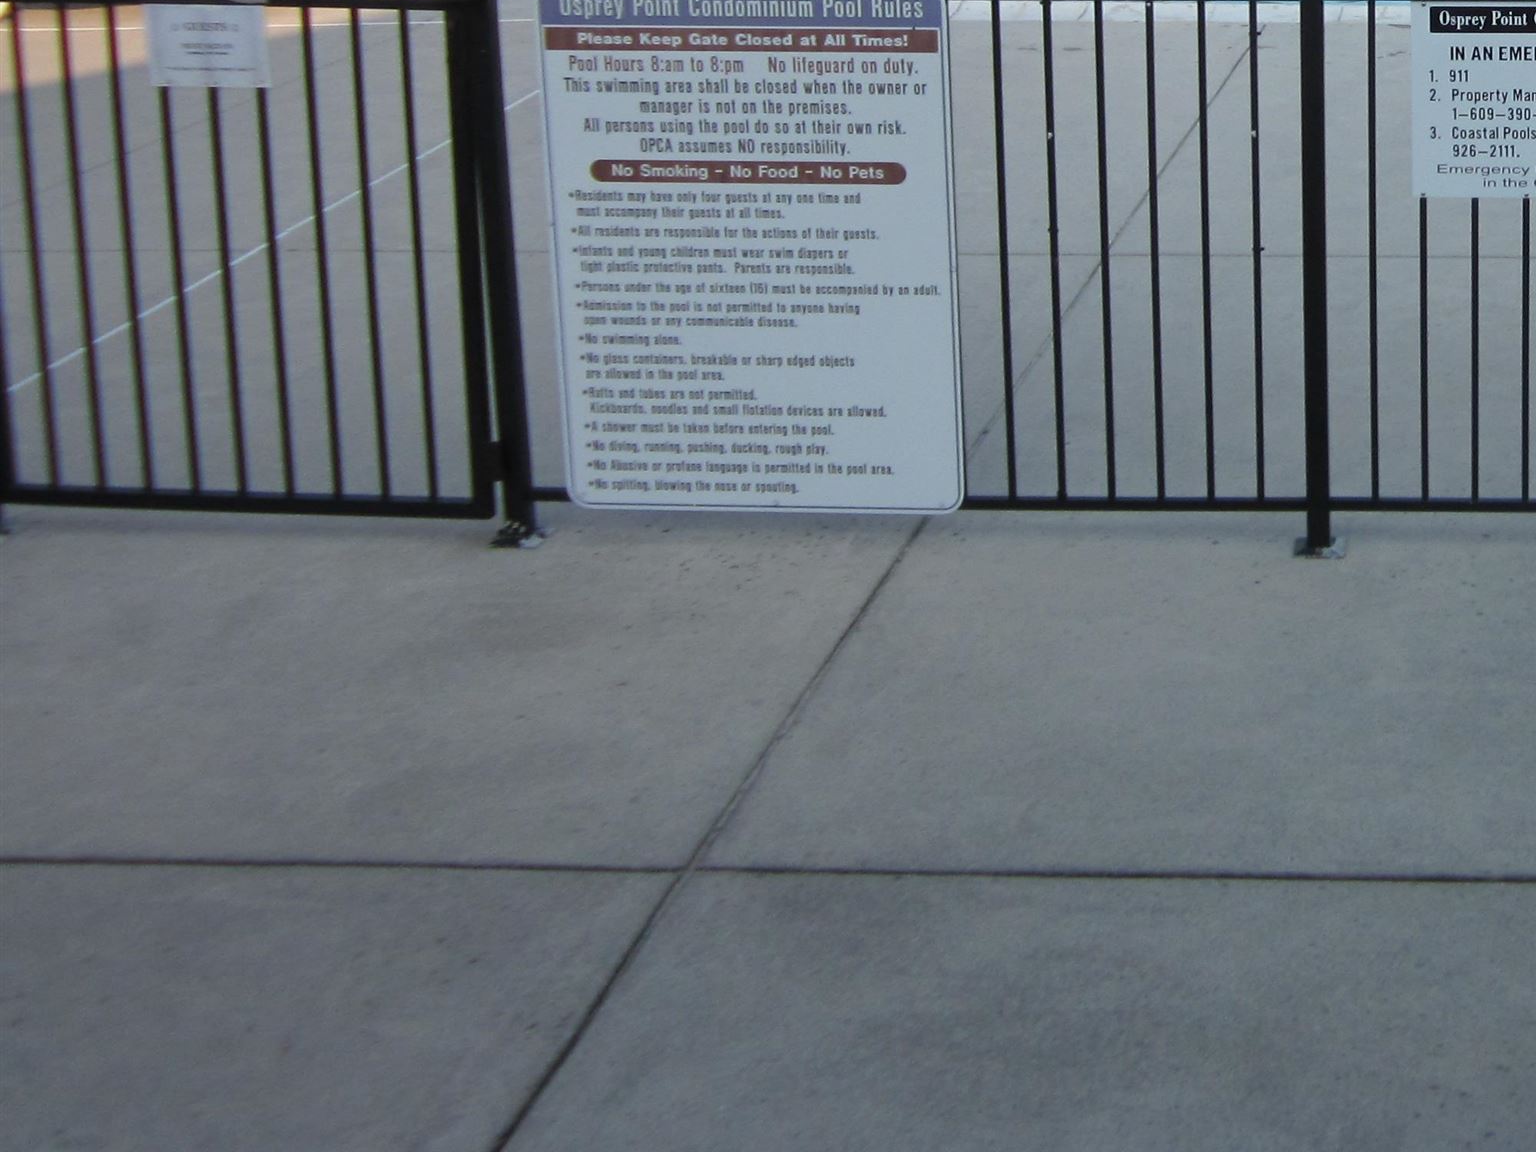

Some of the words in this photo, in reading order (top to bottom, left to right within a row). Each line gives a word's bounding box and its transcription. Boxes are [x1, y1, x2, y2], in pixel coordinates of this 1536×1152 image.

[1439, 10, 1487, 29] Osprey
[1491, 10, 1527, 26] Point
[576, 32, 633, 45] Please
[639, 33, 683, 49] Keep
[688, 33, 728, 46] Gate
[734, 34, 793, 47] Closed
[800, 35, 817, 48] at
[824, 35, 846, 48] All
[852, 35, 908, 48] Times!
[1450, 46, 1465, 61] IN
[1471, 46, 1493, 61] AN
[568, 56, 599, 71] Pool
[603, 57, 644, 72] Hours
[650, 57, 685, 72] 8:am
[690, 57, 704, 72] to
[710, 58, 744, 76] 8:pm
[767, 58, 787, 73] No
[792, 59, 855, 77] lifeguard
[861, 62, 878, 74] on
[883, 60, 919, 78] duty.
[1429, 70, 1439, 82] 1.
[1449, 70, 1469, 82] 911
[564, 77, 591, 92] This
[596, 78, 660, 96] swimming
[665, 81, 693, 93] area
[698, 79, 729, 94] shall
[733, 79, 750, 94] be
[754, 79, 798, 94] closed
[803, 80, 837, 95] when
[842, 80, 863, 95] the
[868, 84, 907, 95] owner
[913, 84, 926, 96] or
[1429, 89, 1441, 102] 2.
[1451, 89, 1508, 104] Property
[639, 102, 692, 116] manager
[698, 99, 710, 113] is
[715, 100, 736, 114] not
[741, 103, 757, 114] on
[762, 100, 783, 114] the
[788, 101, 852, 118] premises.
[583, 117, 601, 132] All
[605, 121, 655, 136] persons
[659, 118, 694, 136] using
[698, 118, 718, 133] the
[723, 119, 750, 137] pool
[754, 119, 769, 134] do
[774, 122, 790, 134] so
[794, 119, 807, 134] at
[812, 120, 841, 135] their
[847, 123, 873, 135] own
[877, 120, 907, 135] risk.
[1430, 127, 1441, 140] 3.
[1452, 127, 1499, 139] Coastal
[1503, 127, 1536, 140] Pools
[639, 138, 673, 153] OPCA
[678, 142, 732, 153] assumes
[737, 139, 756, 154] NO
[760, 140, 851, 158] responsibility.
[1452, 145, 1520, 158] 926-2111.
[611, 165, 634, 179] No
[639, 165, 709, 183] Smoking
[729, 166, 752, 180] No
[757, 166, 799, 180] Food
[819, 167, 843, 181] No
[848, 167, 885, 181] Pets
[1437, 164, 1529, 177] Emergency
[1483, 178, 1497, 188] in
[1503, 178, 1528, 188] the
